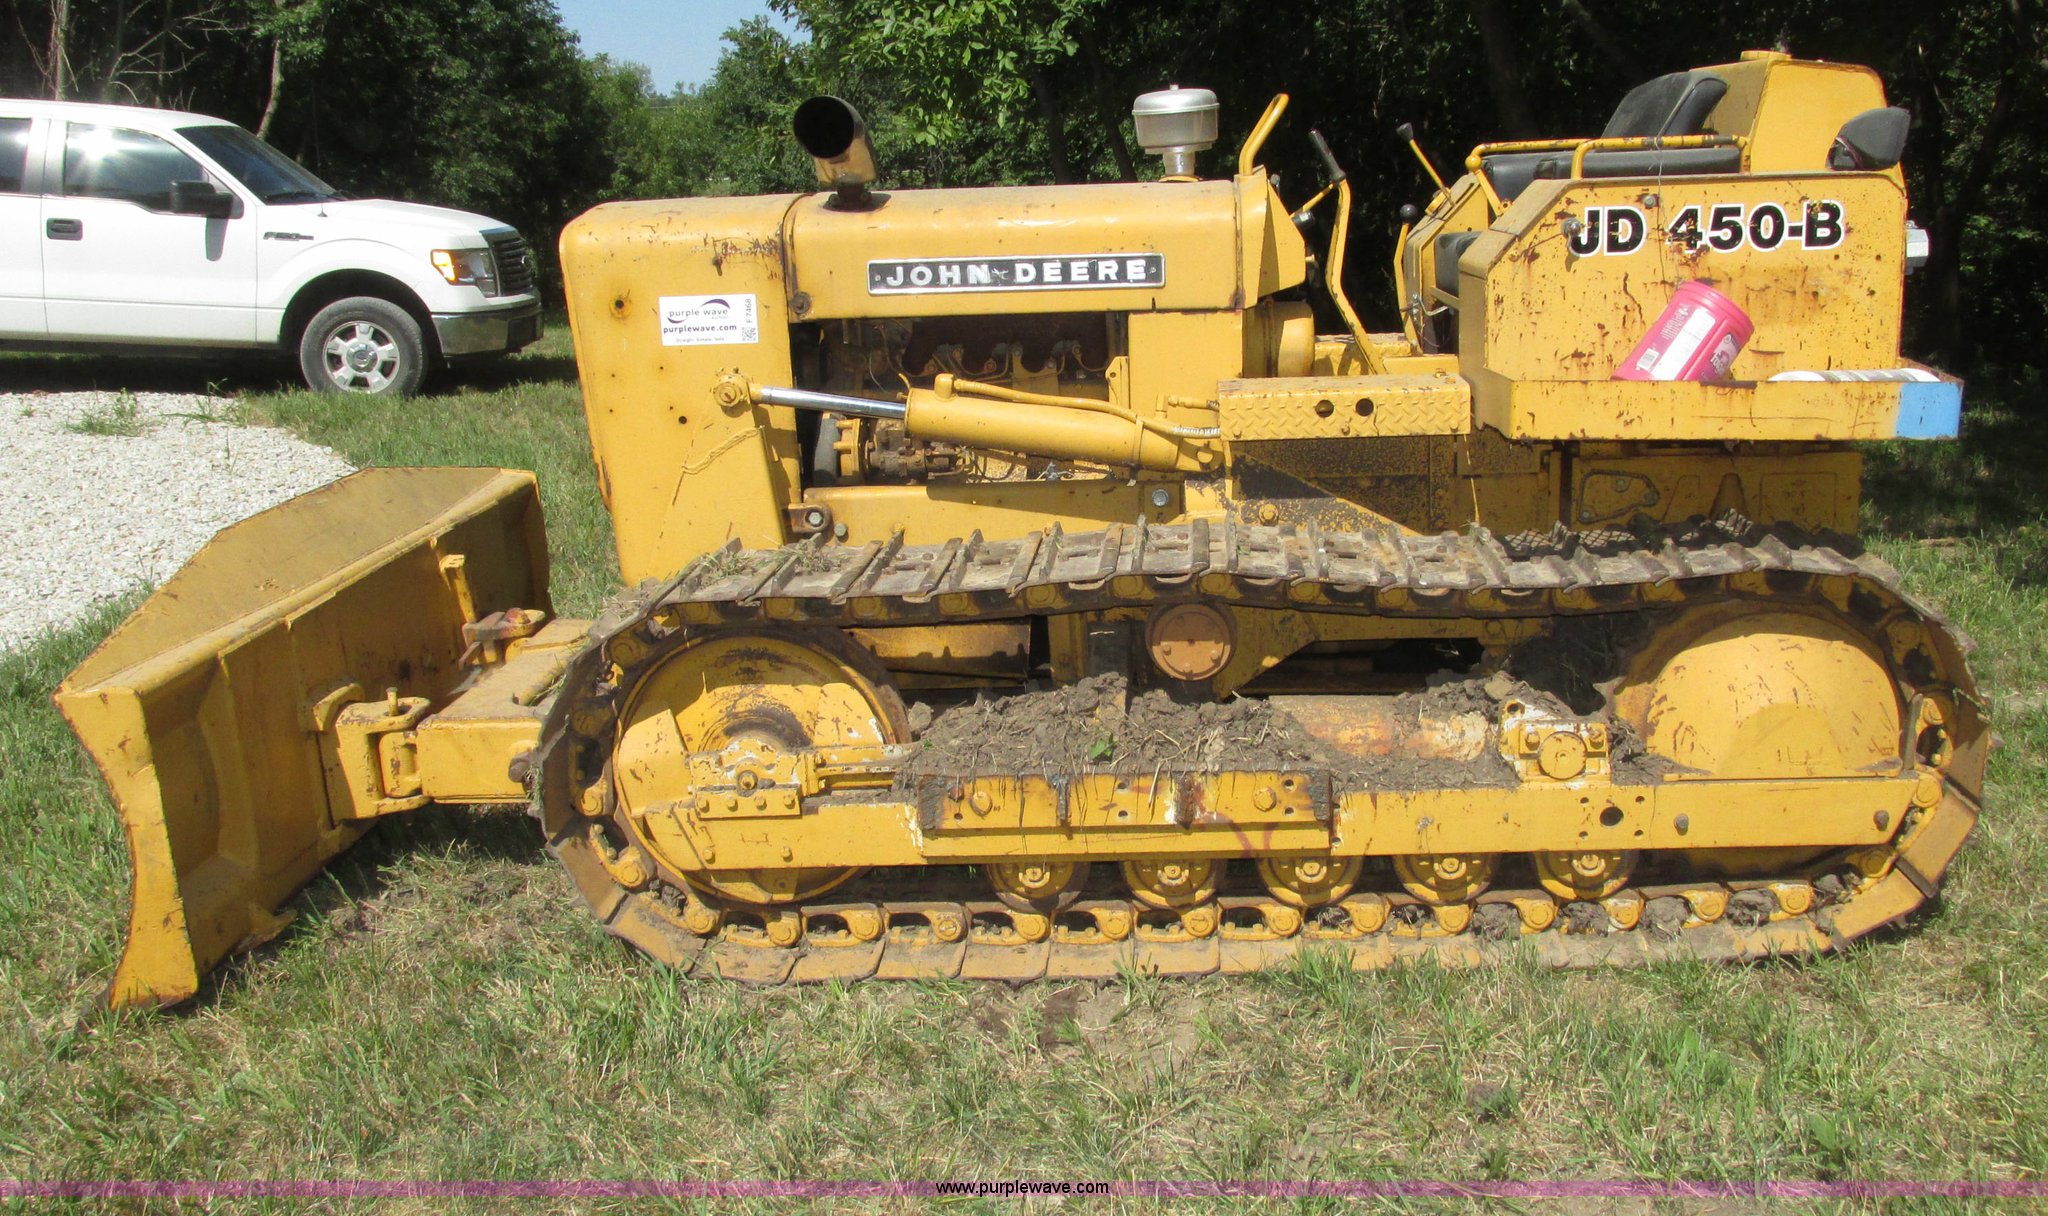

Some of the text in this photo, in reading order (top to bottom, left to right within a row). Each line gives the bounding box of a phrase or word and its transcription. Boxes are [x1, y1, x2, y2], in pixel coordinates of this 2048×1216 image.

[1569, 199, 1845, 258] JD 450-B
[886, 259, 1147, 287] JOHN DEERE
[669, 308, 729, 318] purple wave
[663, 324, 737, 335] purplewave.com
